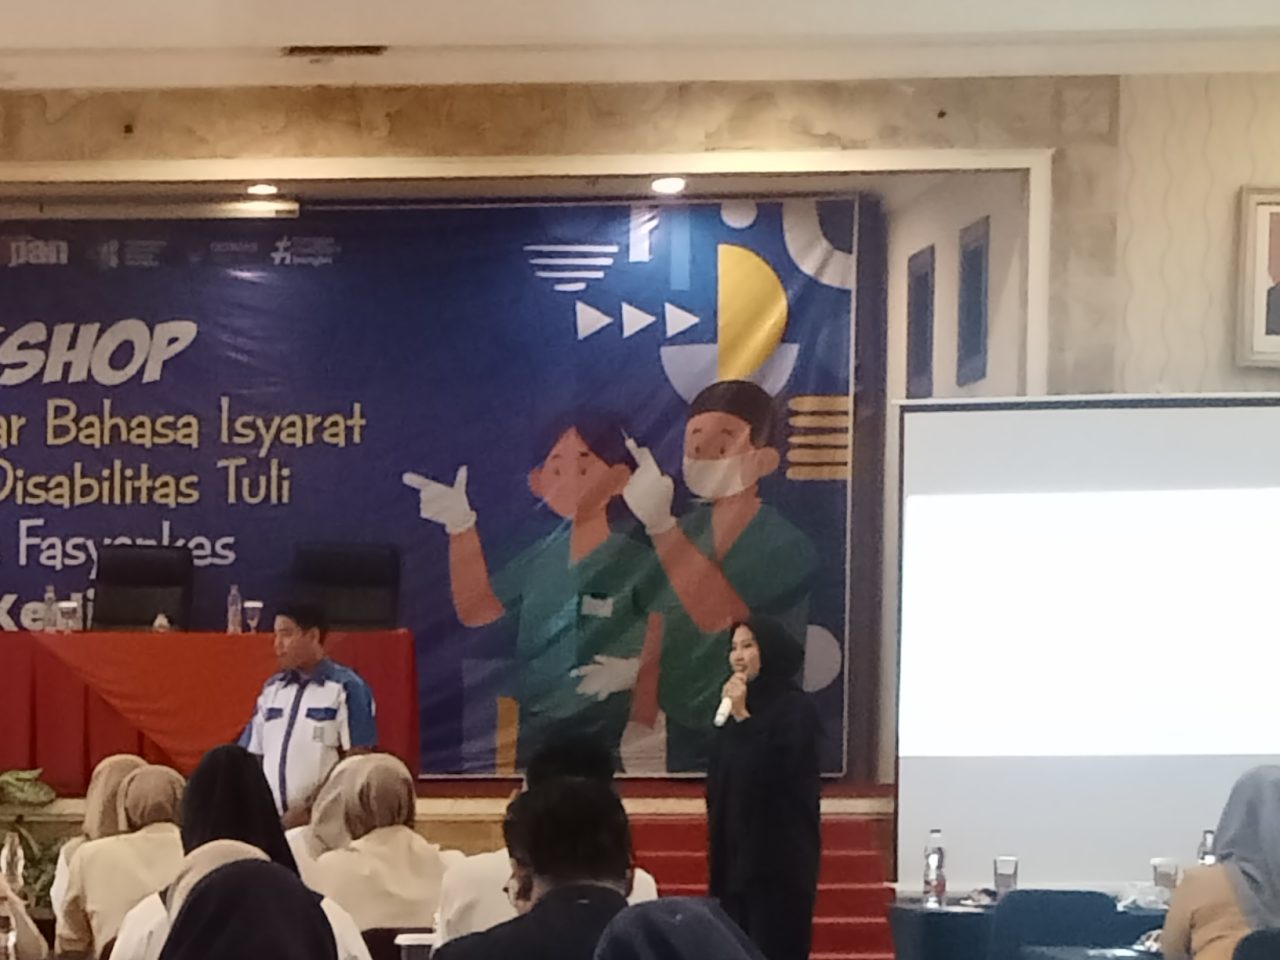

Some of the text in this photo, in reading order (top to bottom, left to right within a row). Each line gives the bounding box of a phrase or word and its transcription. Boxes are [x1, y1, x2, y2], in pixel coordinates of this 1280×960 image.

[46, 398, 199, 449] Bahasa
[220, 396, 366, 457] Isyarat
[217, 457, 291, 505] Tuli
